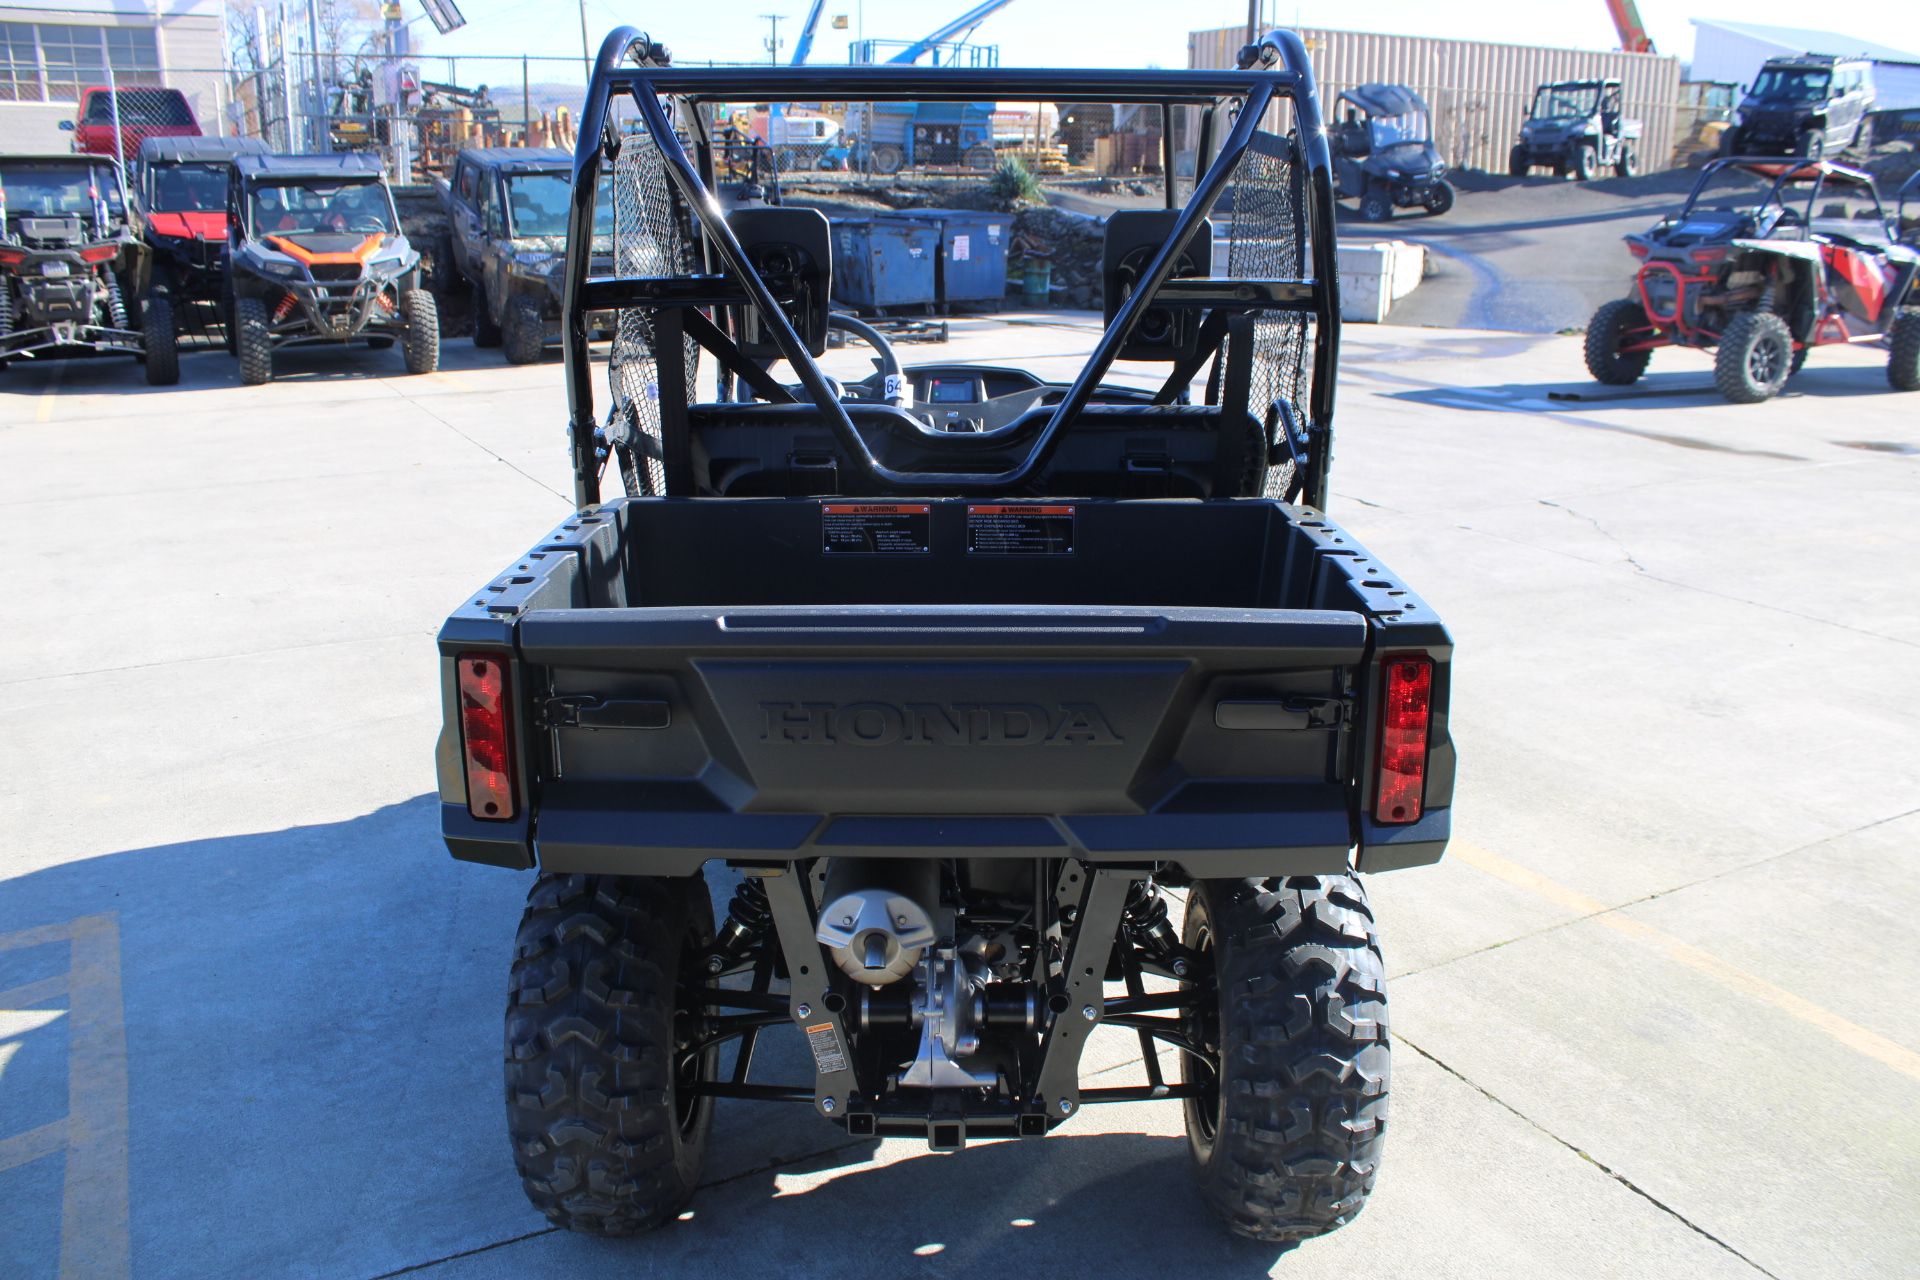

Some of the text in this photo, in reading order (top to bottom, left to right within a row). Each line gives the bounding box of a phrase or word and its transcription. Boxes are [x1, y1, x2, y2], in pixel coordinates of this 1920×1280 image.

[860, 505, 898, 513] WARNING
[1008, 506, 1042, 514] WARNING
[758, 702, 1124, 746] HONDA
